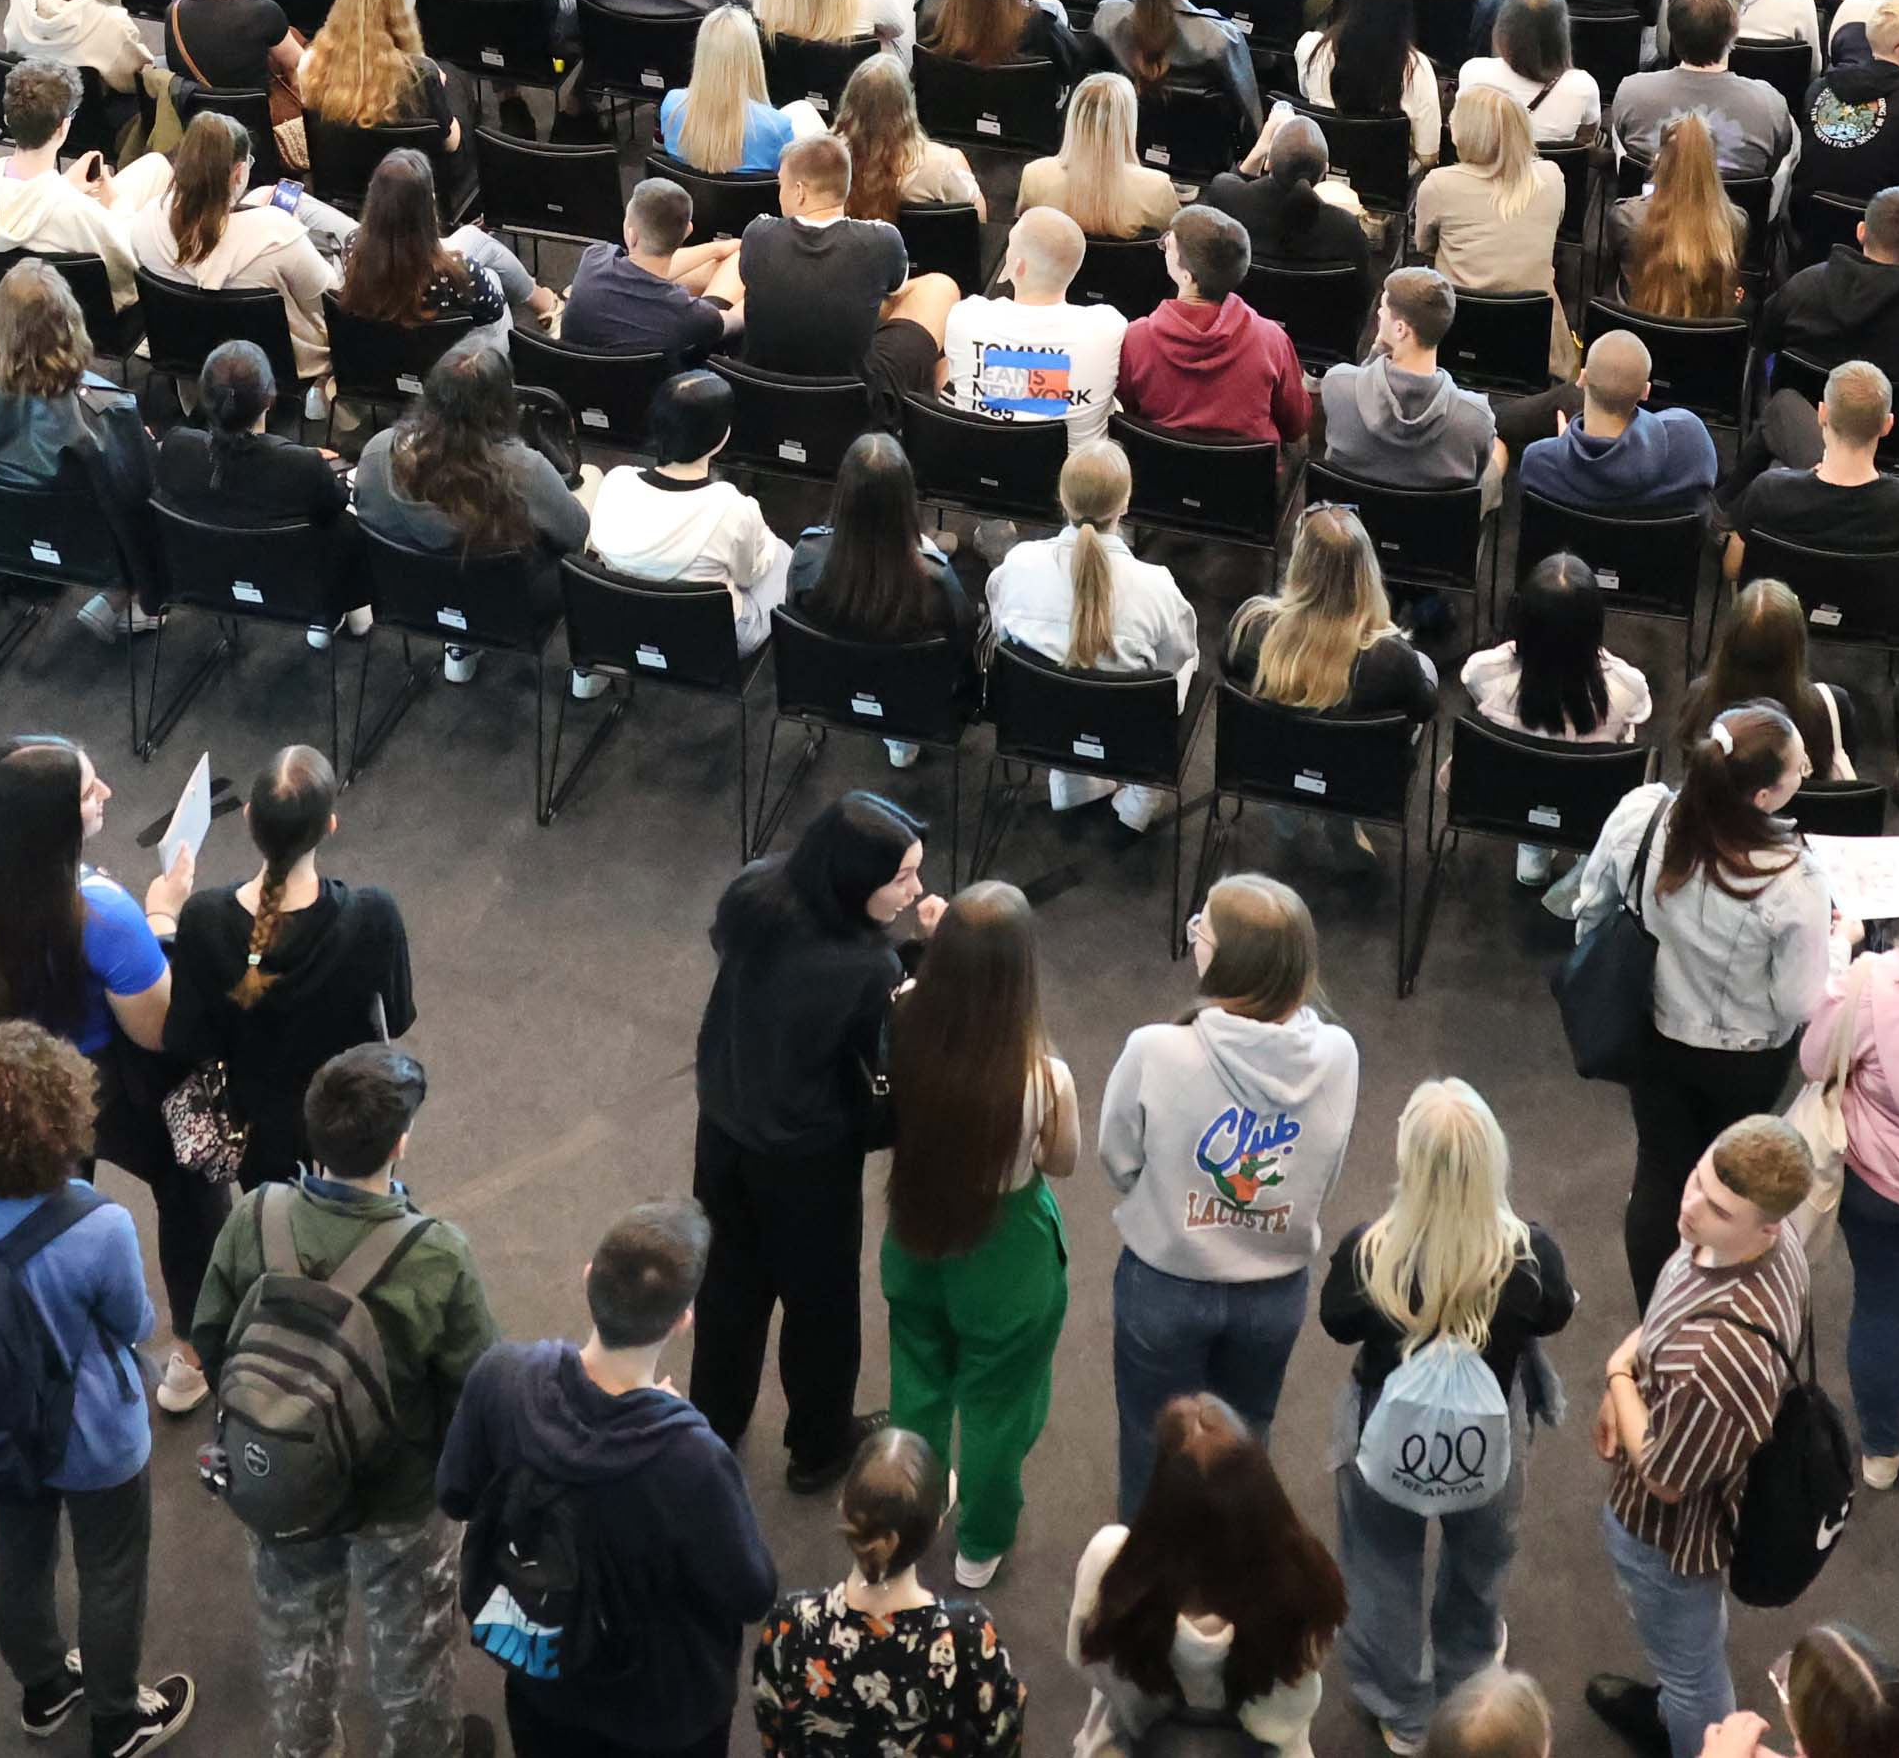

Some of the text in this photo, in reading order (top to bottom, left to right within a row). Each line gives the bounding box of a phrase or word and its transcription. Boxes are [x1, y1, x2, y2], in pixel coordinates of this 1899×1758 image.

[1832, 140, 1856, 149] FACE
[1855, 127, 1880, 146] SINCE
[1028, 386, 1093, 407] YORK
[1196, 1107, 1302, 1174] Club
[1185, 1189, 1294, 1234] LACOSTE
